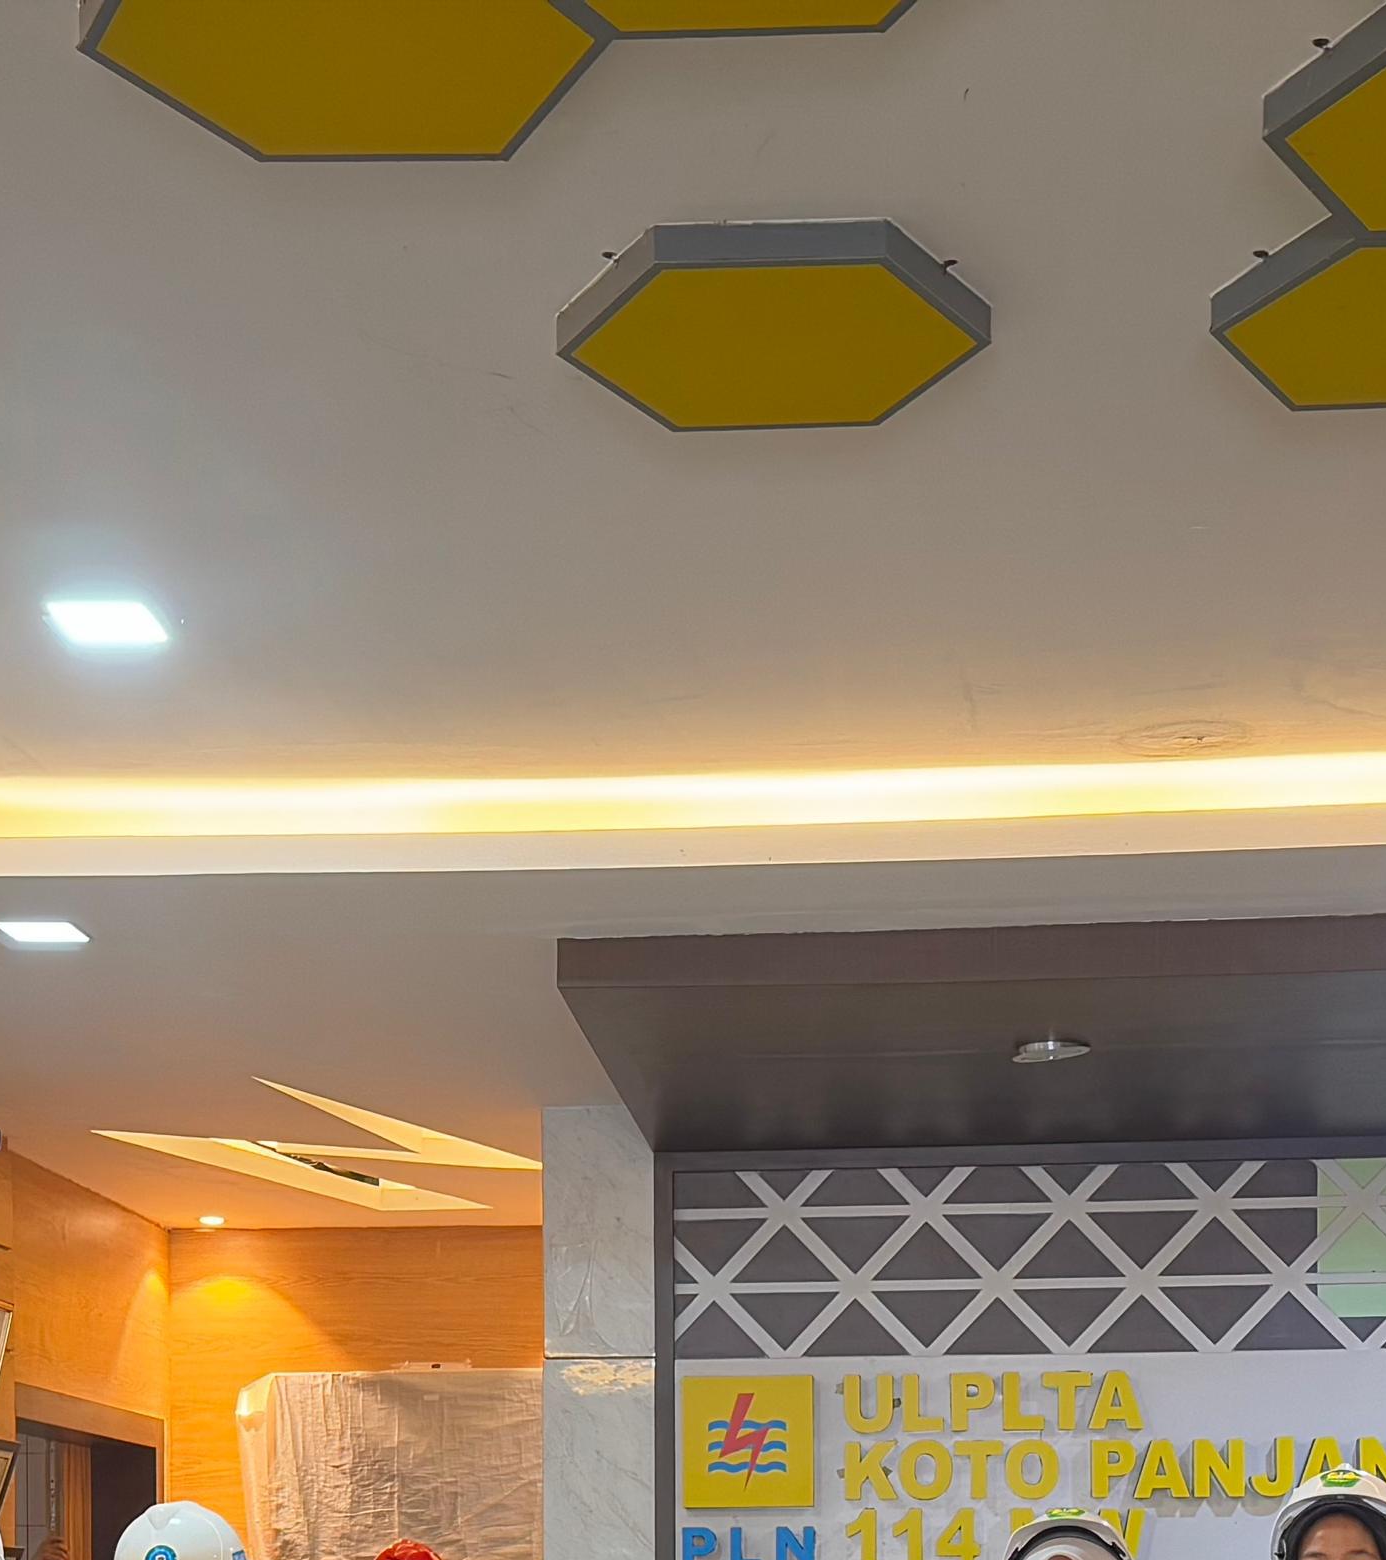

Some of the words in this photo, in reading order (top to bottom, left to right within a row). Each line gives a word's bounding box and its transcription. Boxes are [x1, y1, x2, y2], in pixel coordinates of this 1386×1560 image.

[843, 1369, 1143, 1433] ULPLTA
[843, 1438, 1060, 1501] KOTO
[1009, 1507, 1147, 1560] W
